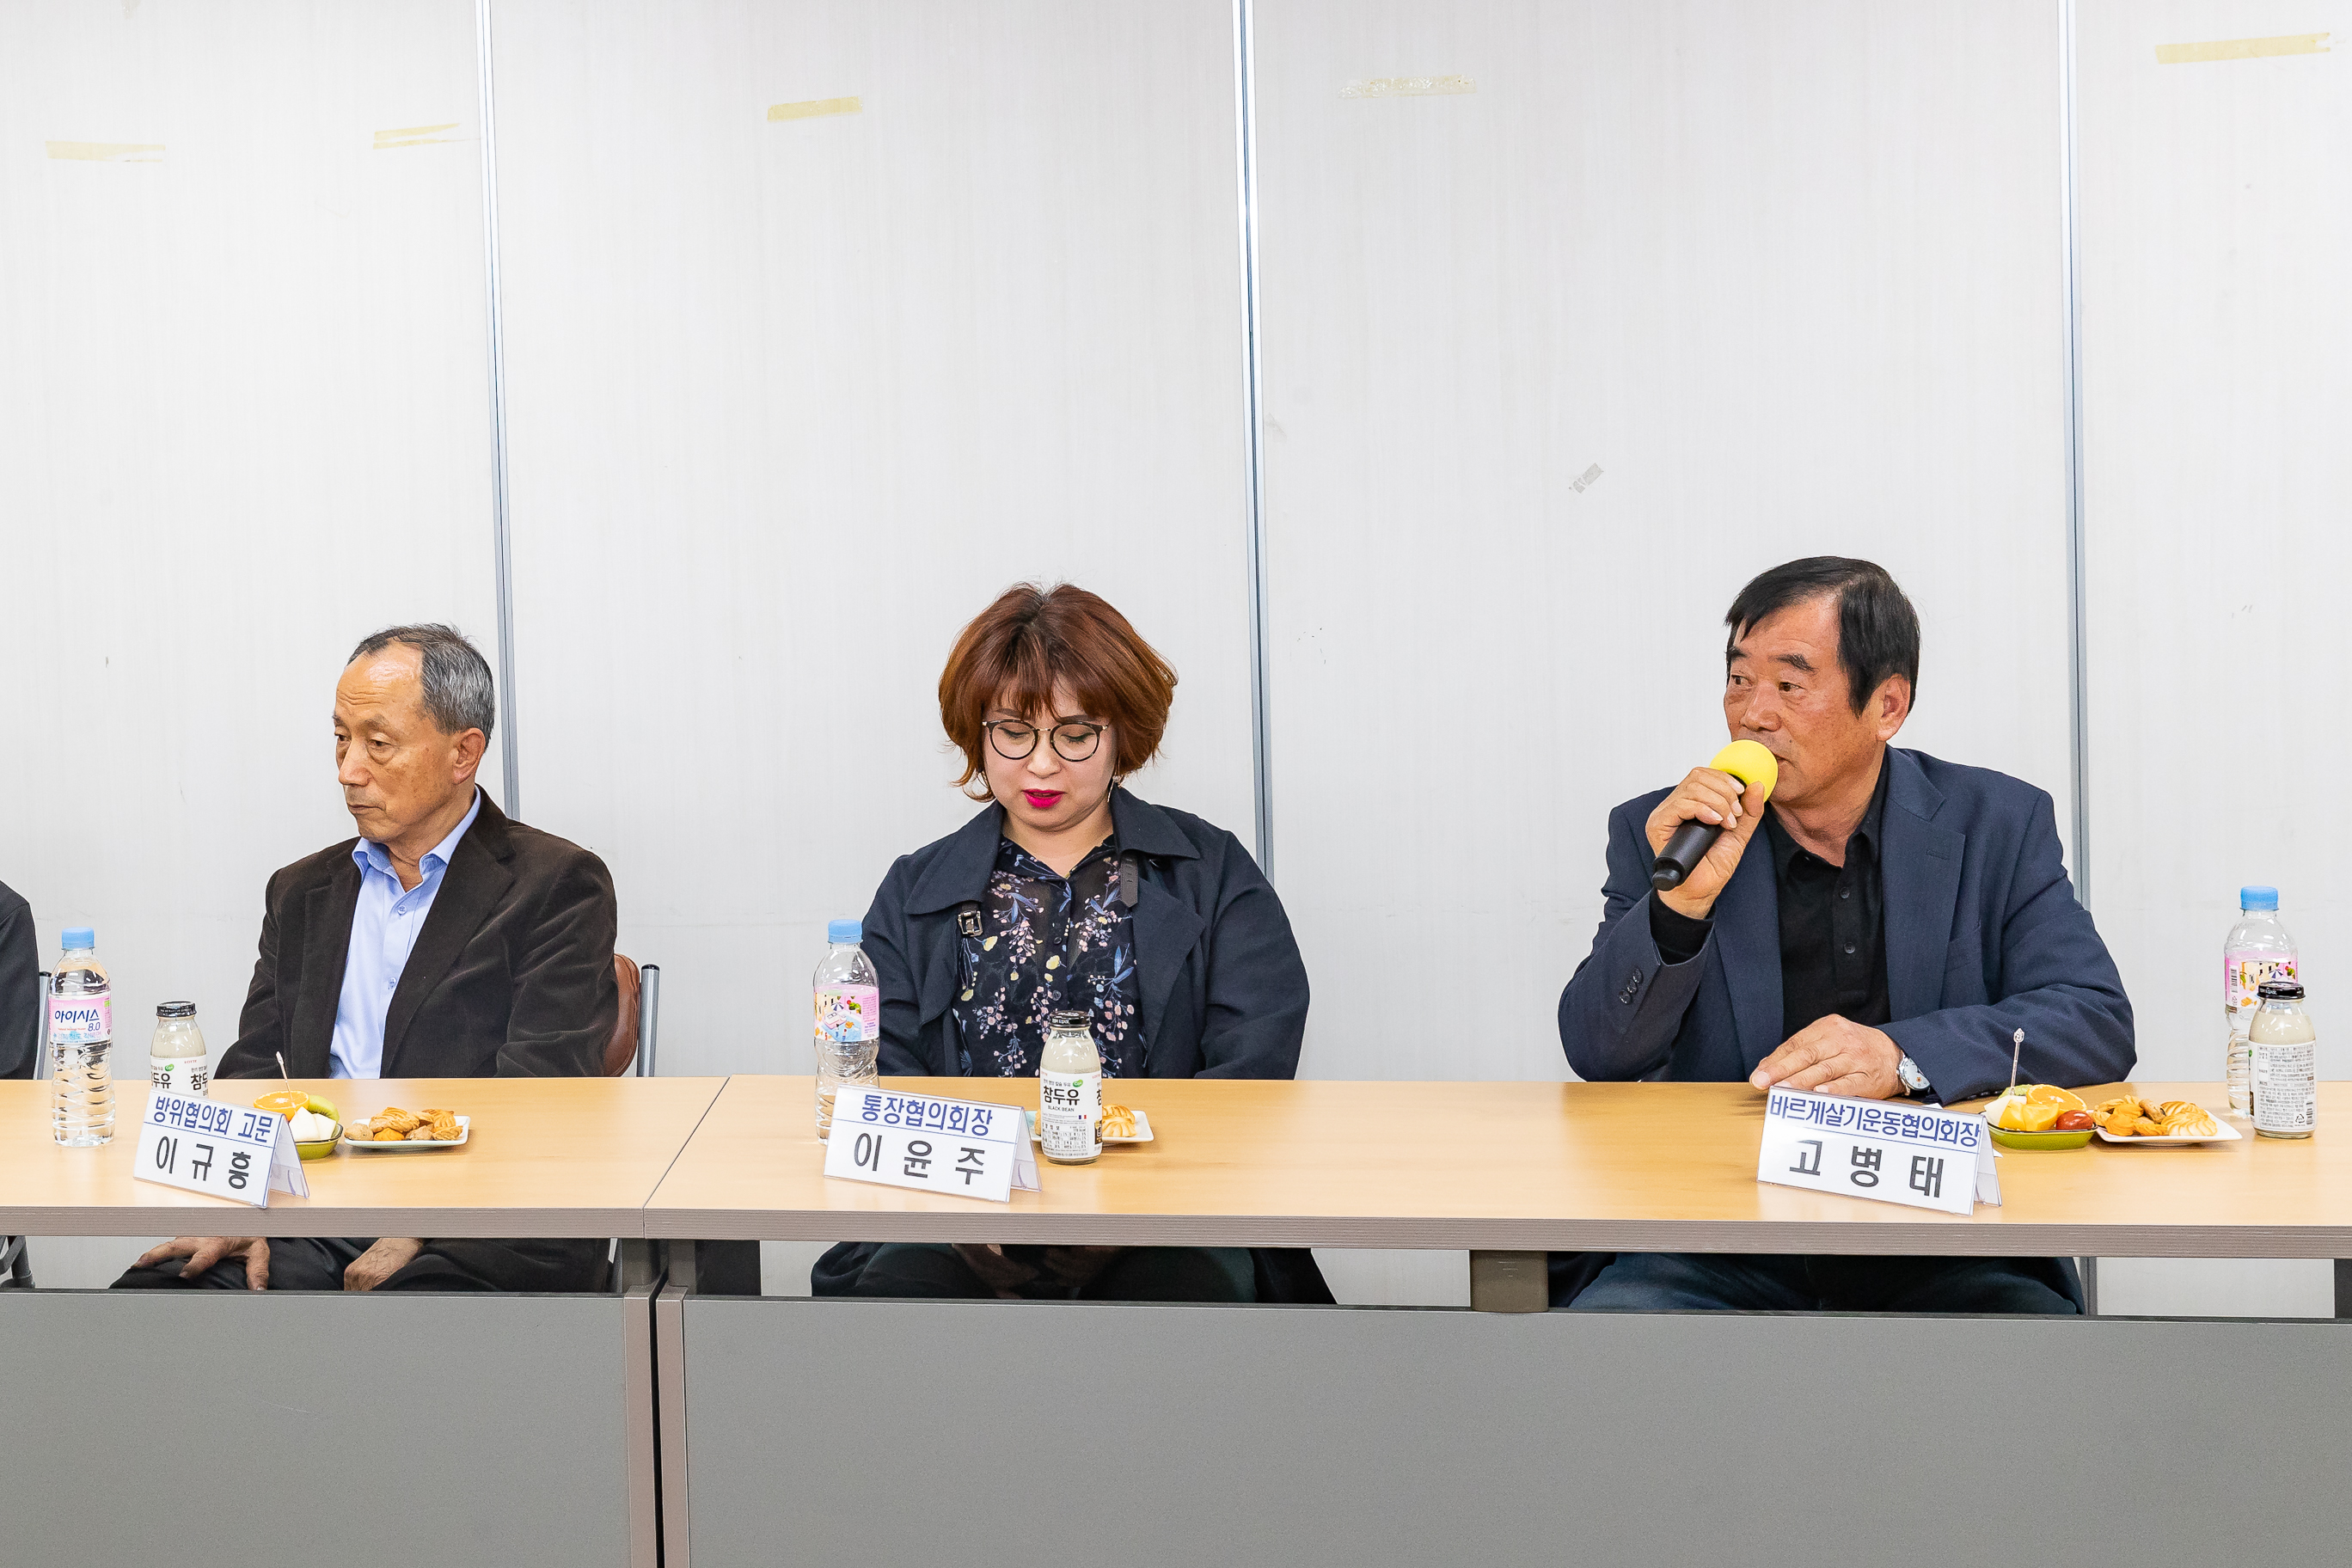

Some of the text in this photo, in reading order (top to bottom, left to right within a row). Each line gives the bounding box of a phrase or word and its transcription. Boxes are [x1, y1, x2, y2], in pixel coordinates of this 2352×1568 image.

[54, 1008, 100, 1023] 아이시스
[88, 1021, 101, 1032] 8.0
[1043, 1086, 1081, 1106] 참두유
[153, 1096, 273, 1142] 방위협의회 고문
[861, 1094, 993, 1136] 통장협의회장
[1769, 1094, 1981, 1148] 바르게살기운동협의회장
